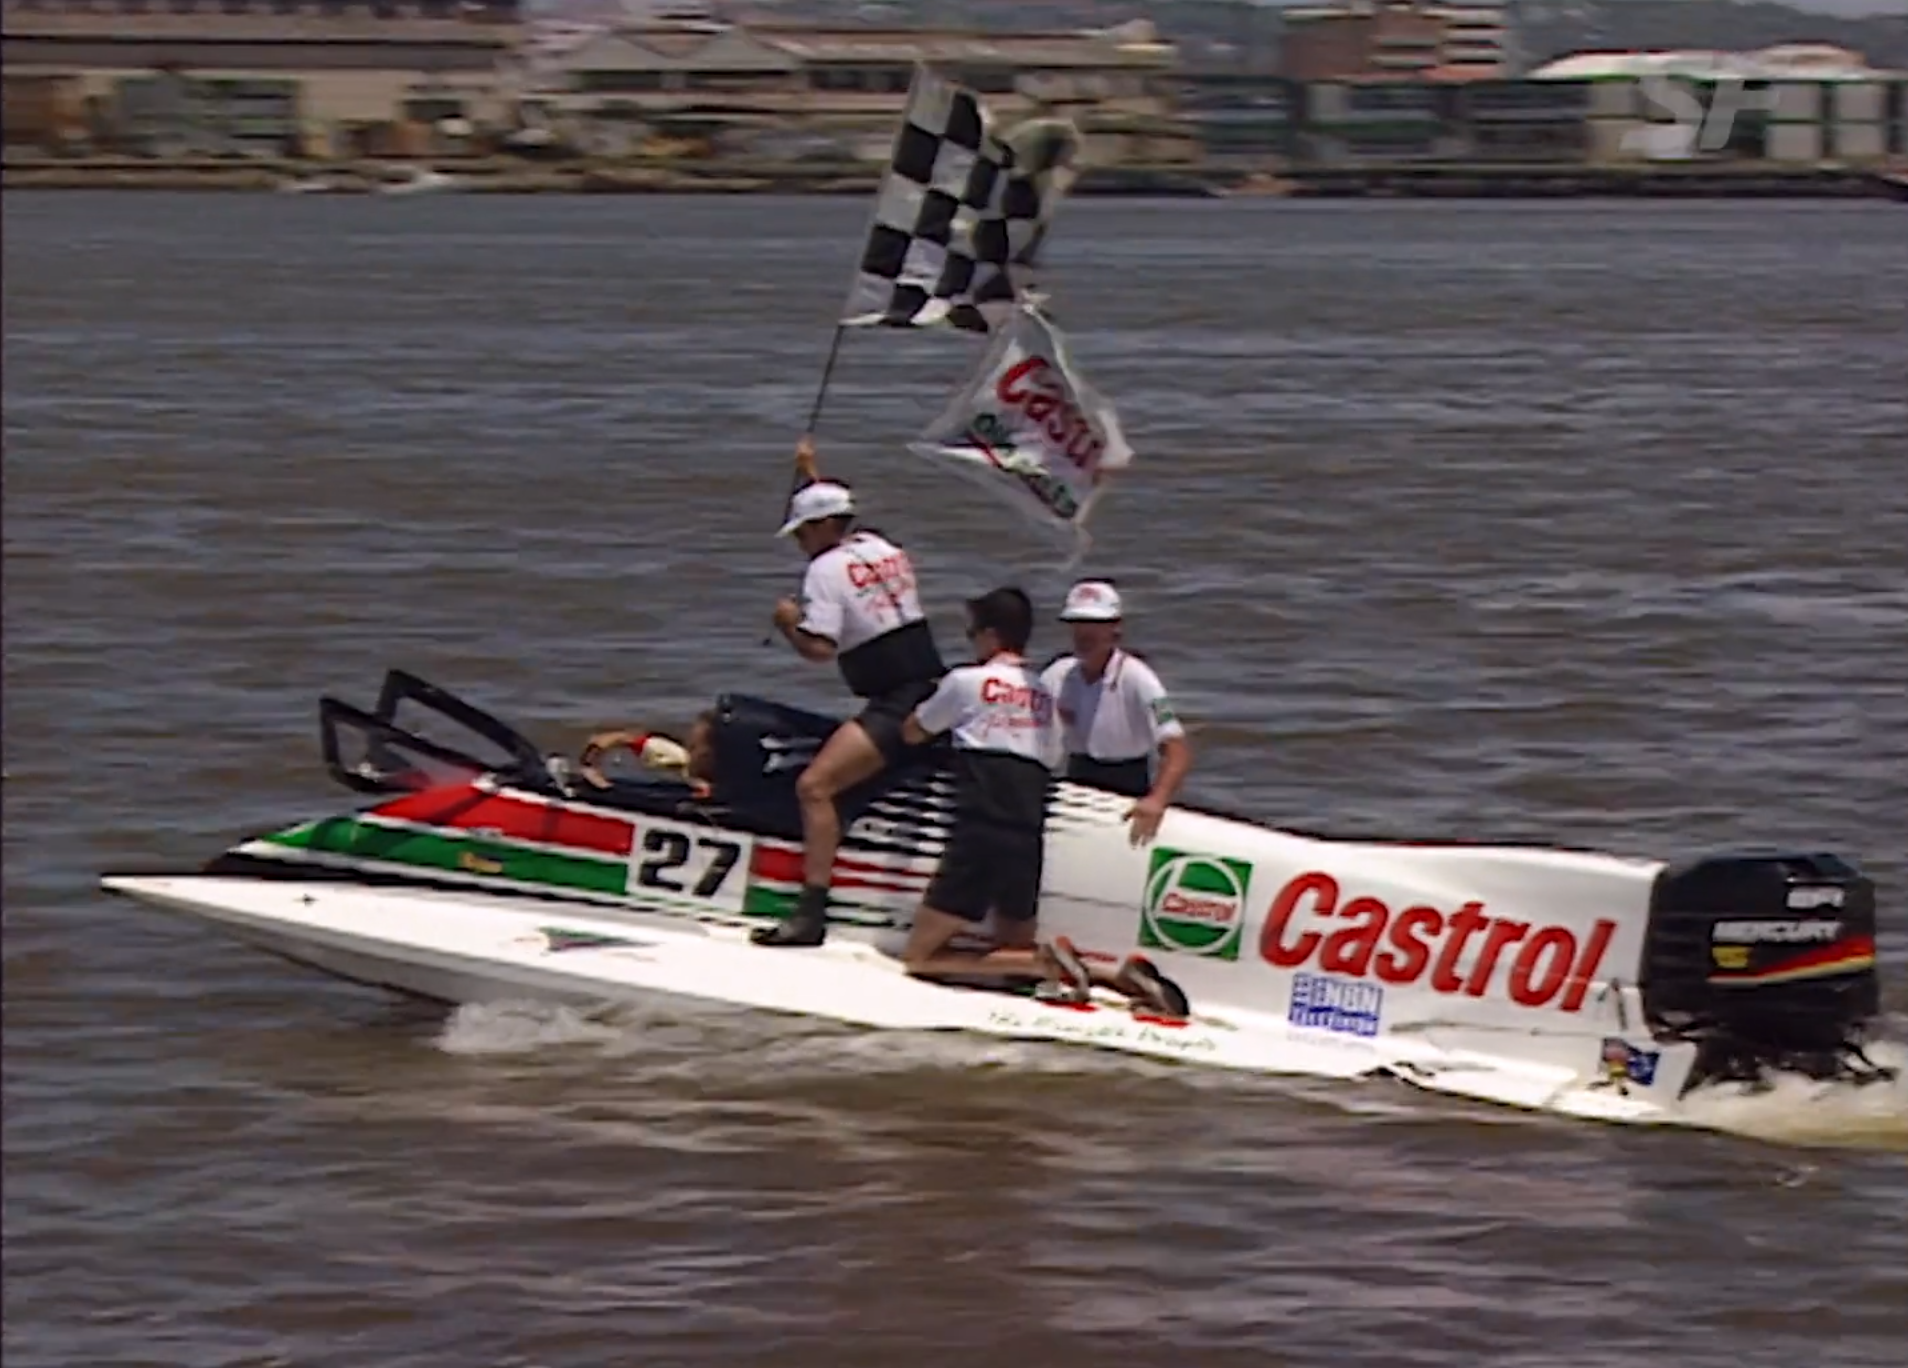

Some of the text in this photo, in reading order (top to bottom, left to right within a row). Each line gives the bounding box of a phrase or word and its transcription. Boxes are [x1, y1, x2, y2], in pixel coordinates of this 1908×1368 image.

[638, 828, 741, 898] 27
[1162, 892, 1238, 922] Castrol
[1711, 920, 1844, 943] MERCURY
[1260, 871, 1618, 1013] Castrol
